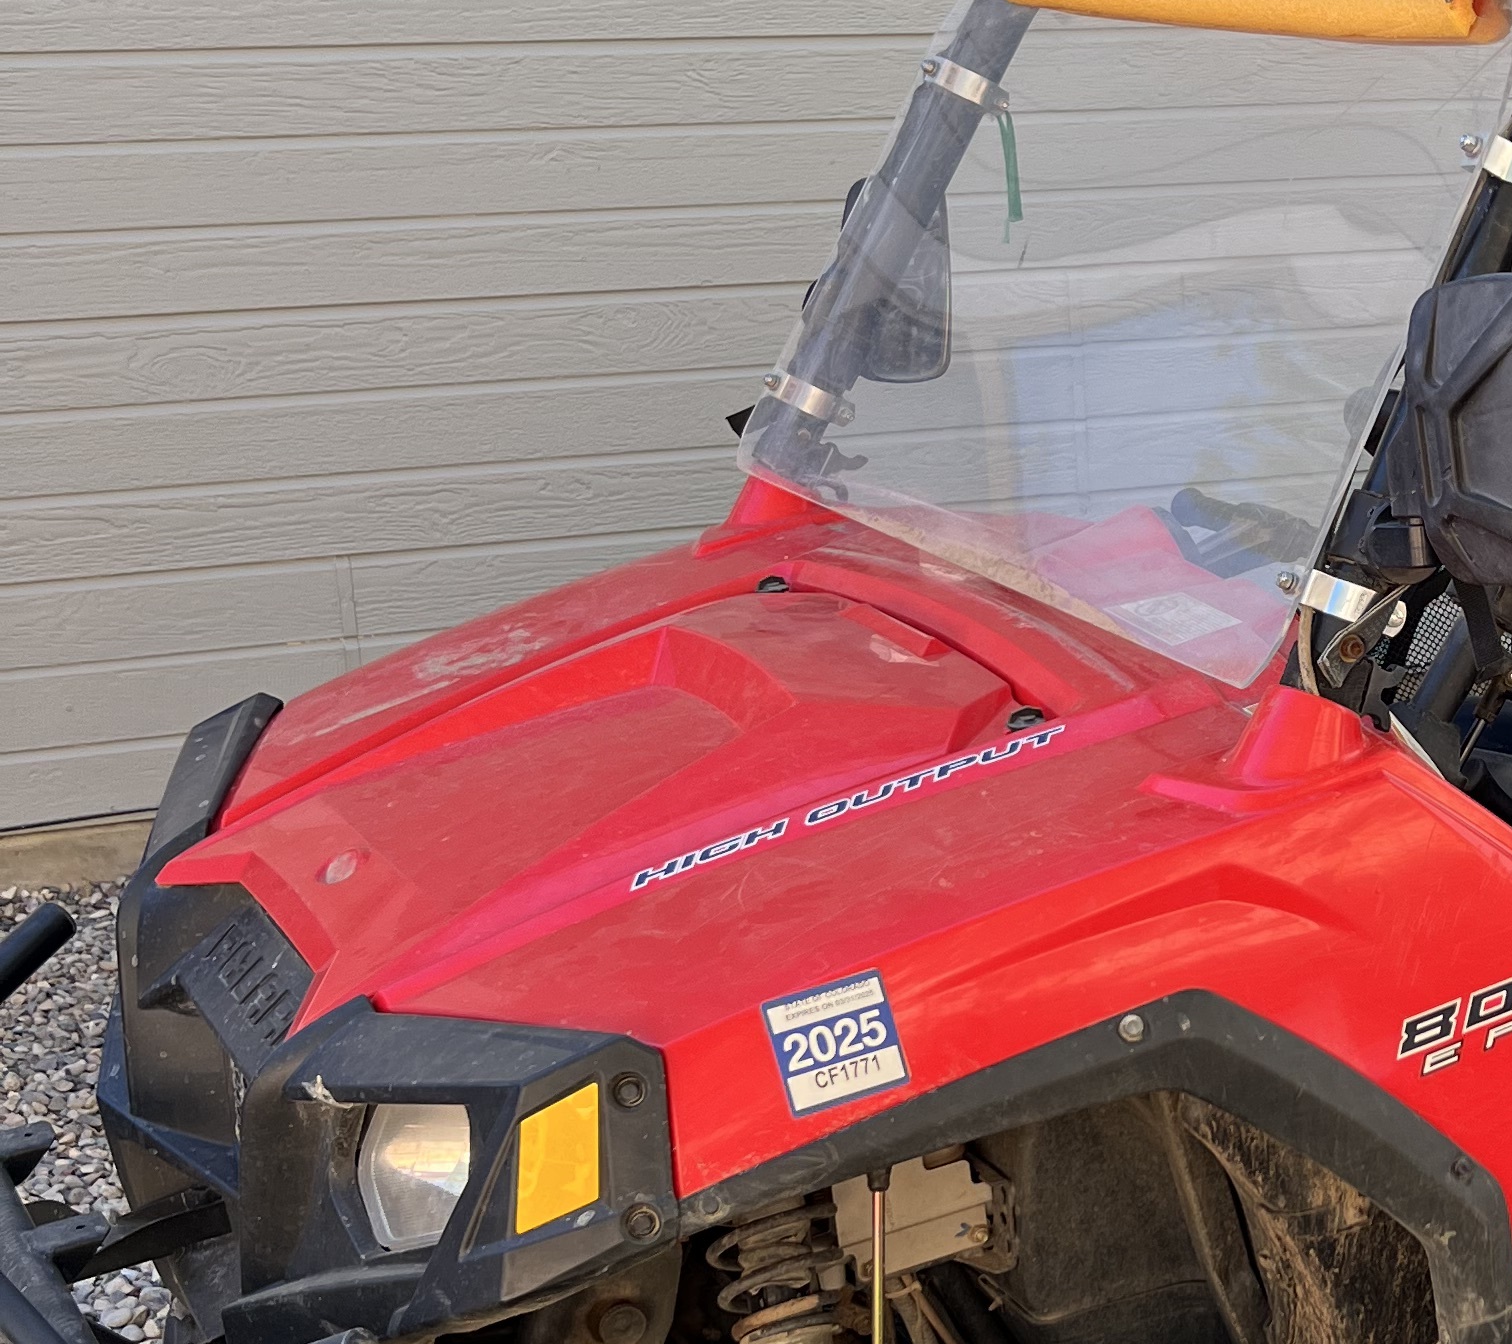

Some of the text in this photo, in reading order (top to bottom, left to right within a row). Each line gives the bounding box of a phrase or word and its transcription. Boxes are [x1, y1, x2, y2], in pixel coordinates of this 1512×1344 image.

[629, 724, 1066, 892] HIGH OUTPUT
[785, 1006, 820, 1021] EXPIRES
[783, 1008, 887, 1072] 2025
[815, 1054, 881, 1088] CF1771
